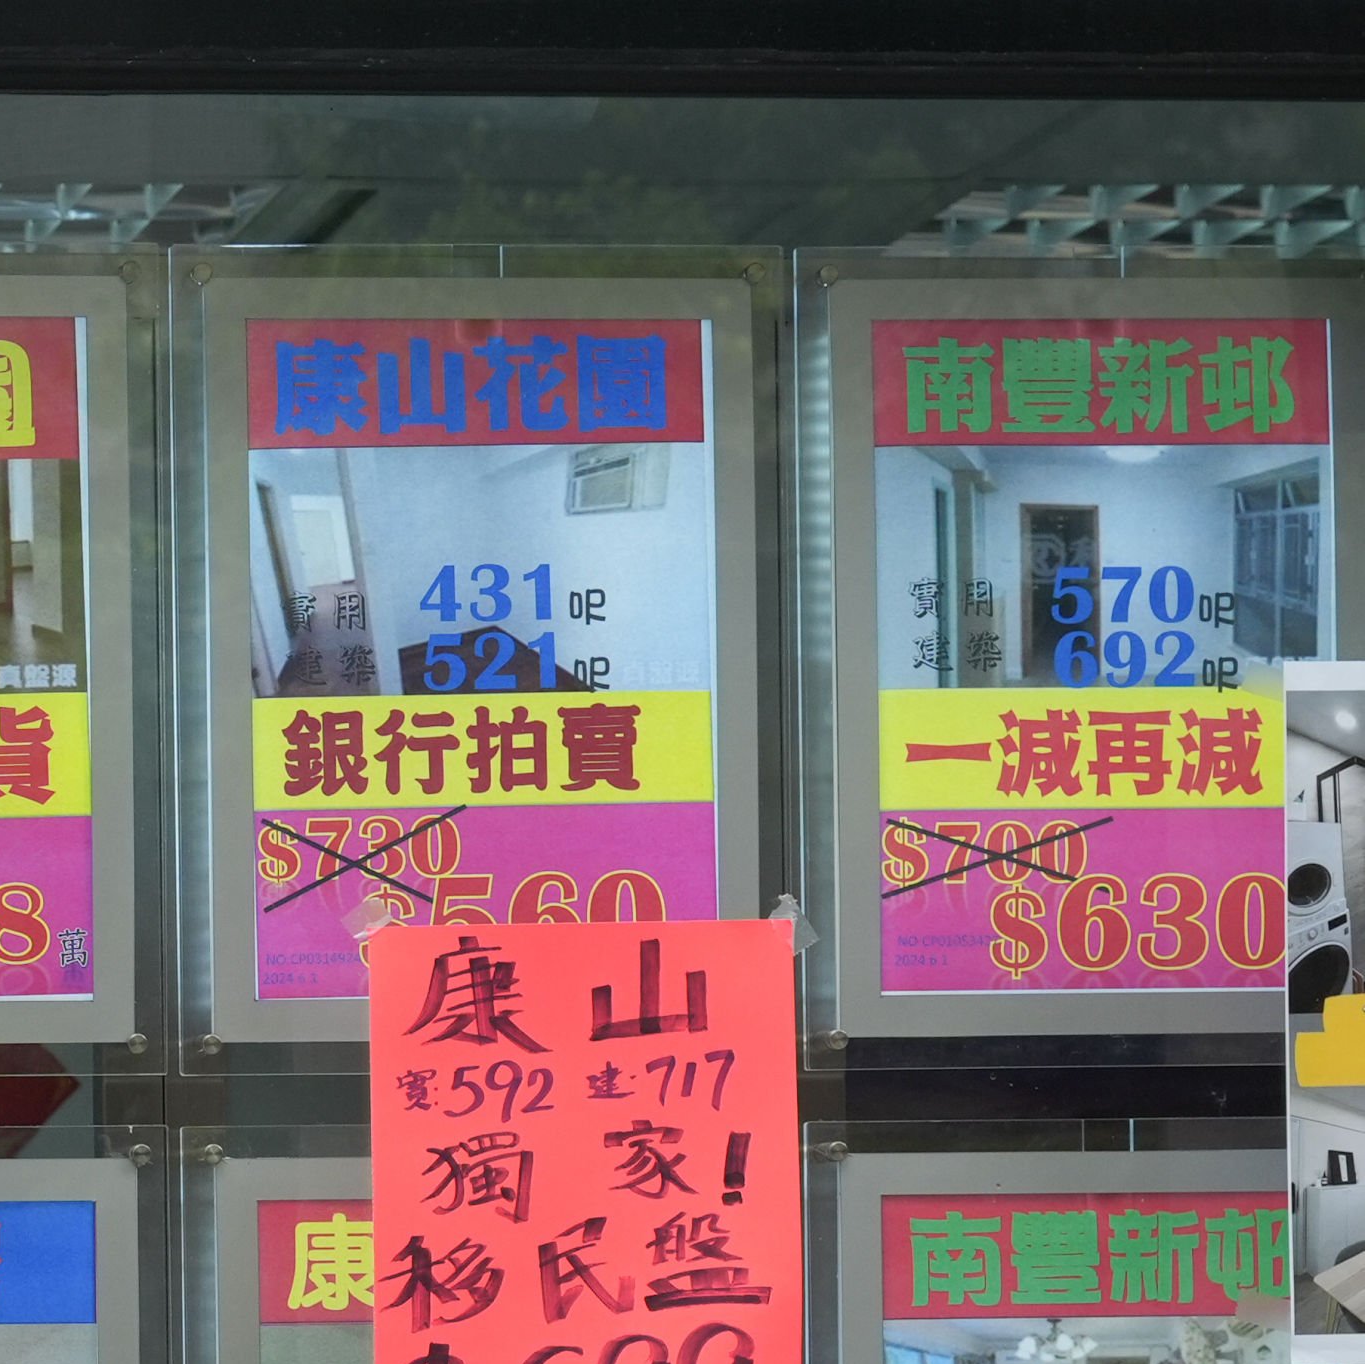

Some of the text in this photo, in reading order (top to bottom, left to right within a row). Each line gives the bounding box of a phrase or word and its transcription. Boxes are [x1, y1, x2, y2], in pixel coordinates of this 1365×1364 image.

[273, 333, 669, 436] 康山花園
[903, 335, 1296, 436] 南豐新邨
[420, 563, 553, 623] 431
[1050, 564, 1196, 626] 570
[423, 631, 558, 692] 521
[1052, 629, 1197, 690] 692
[282, 702, 643, 798] 銀行拍賣
[904, 707, 1264, 800] 一減再減
[256, 814, 463, 887] $730
[881, 815, 1089, 892] $700
[988, 871, 1285, 981] $630
